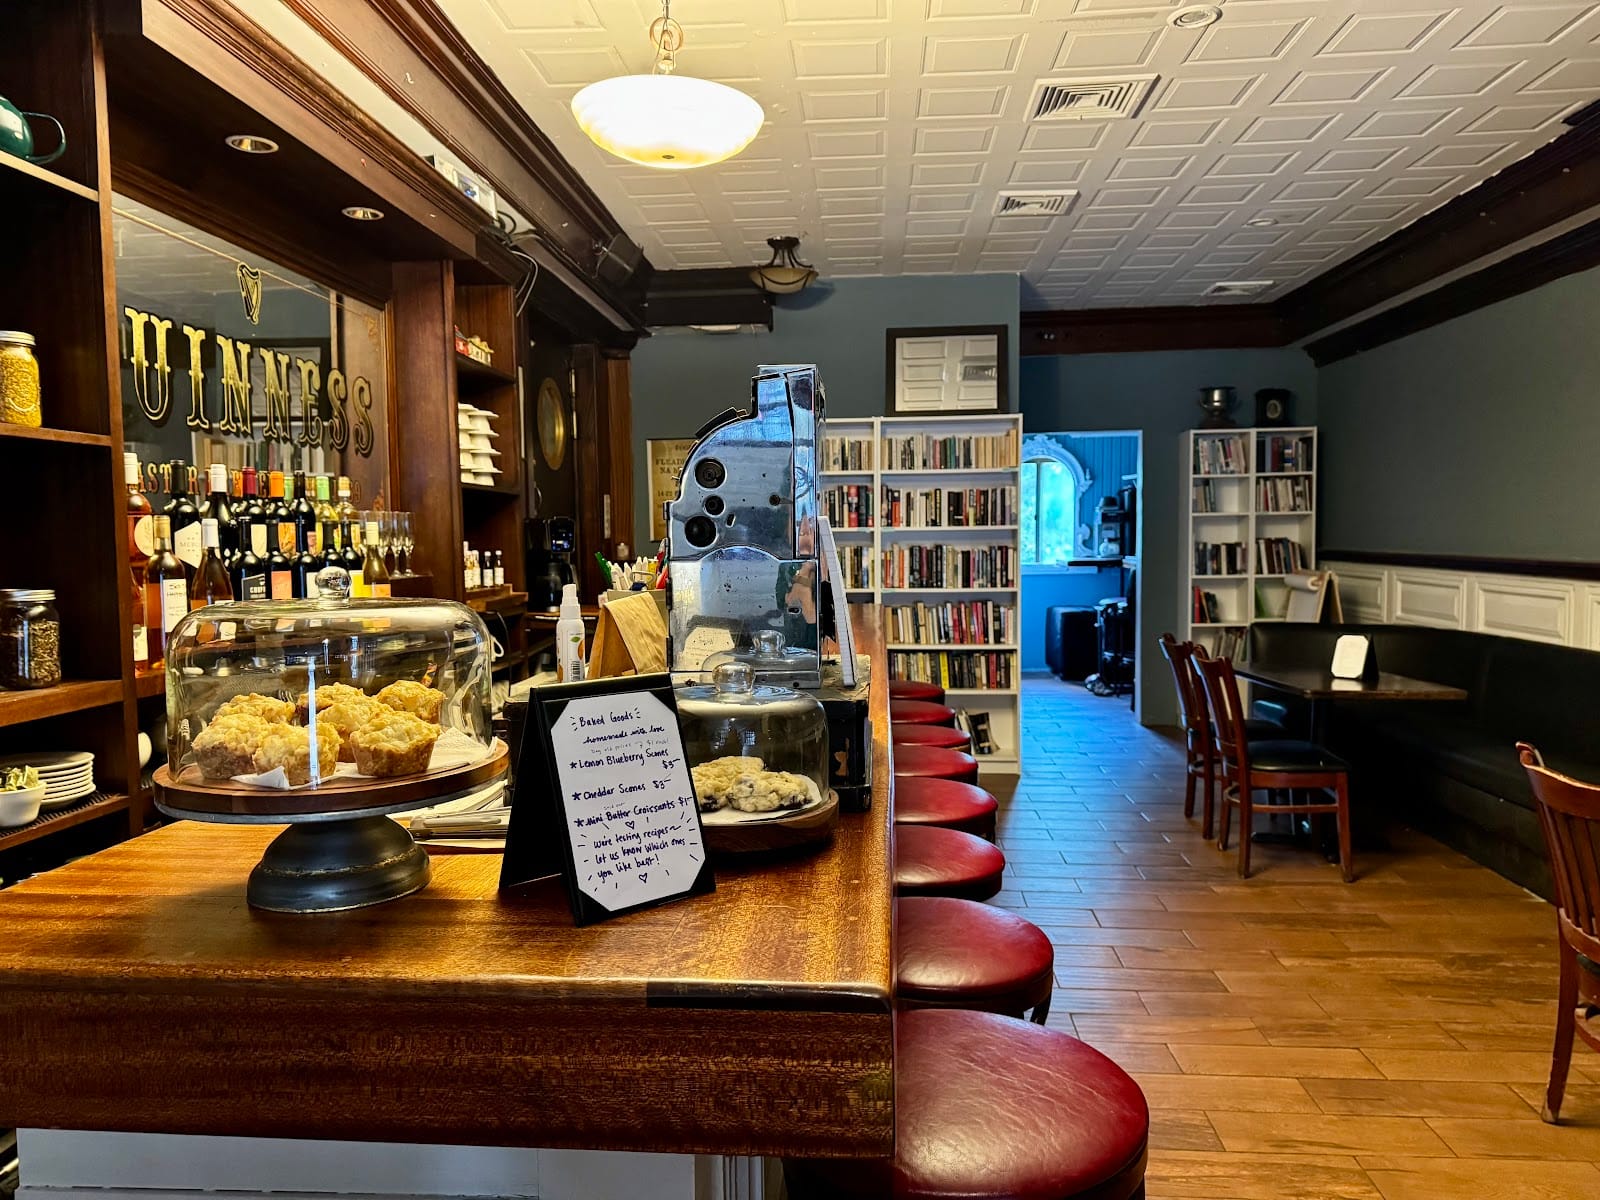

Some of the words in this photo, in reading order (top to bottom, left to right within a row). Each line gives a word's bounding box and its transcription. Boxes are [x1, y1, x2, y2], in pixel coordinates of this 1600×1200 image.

[124, 306, 374, 458] UINNESS
[579, 714, 605, 727] Baked
[609, 711, 633, 722] Goods
[583, 730, 628, 744] homemade
[649, 724, 665, 733] love
[579, 759, 604, 768] Lemon
[606, 752, 645, 766] Blueberry
[645, 748, 669, 758] Scones
[583, 787, 615, 800] Cheddar
[618, 783, 646, 793] Scones
[606, 809, 631, 821] Butter
[633, 800, 675, 816] Croissants
[615, 832, 642, 844] testing
[609, 852, 619, 861] us
[621, 846, 642, 856] know
[671, 838, 686, 846] ones
[597, 870, 613, 884] you
[616, 862, 632, 872] like
[634, 853, 660, 868] best!
